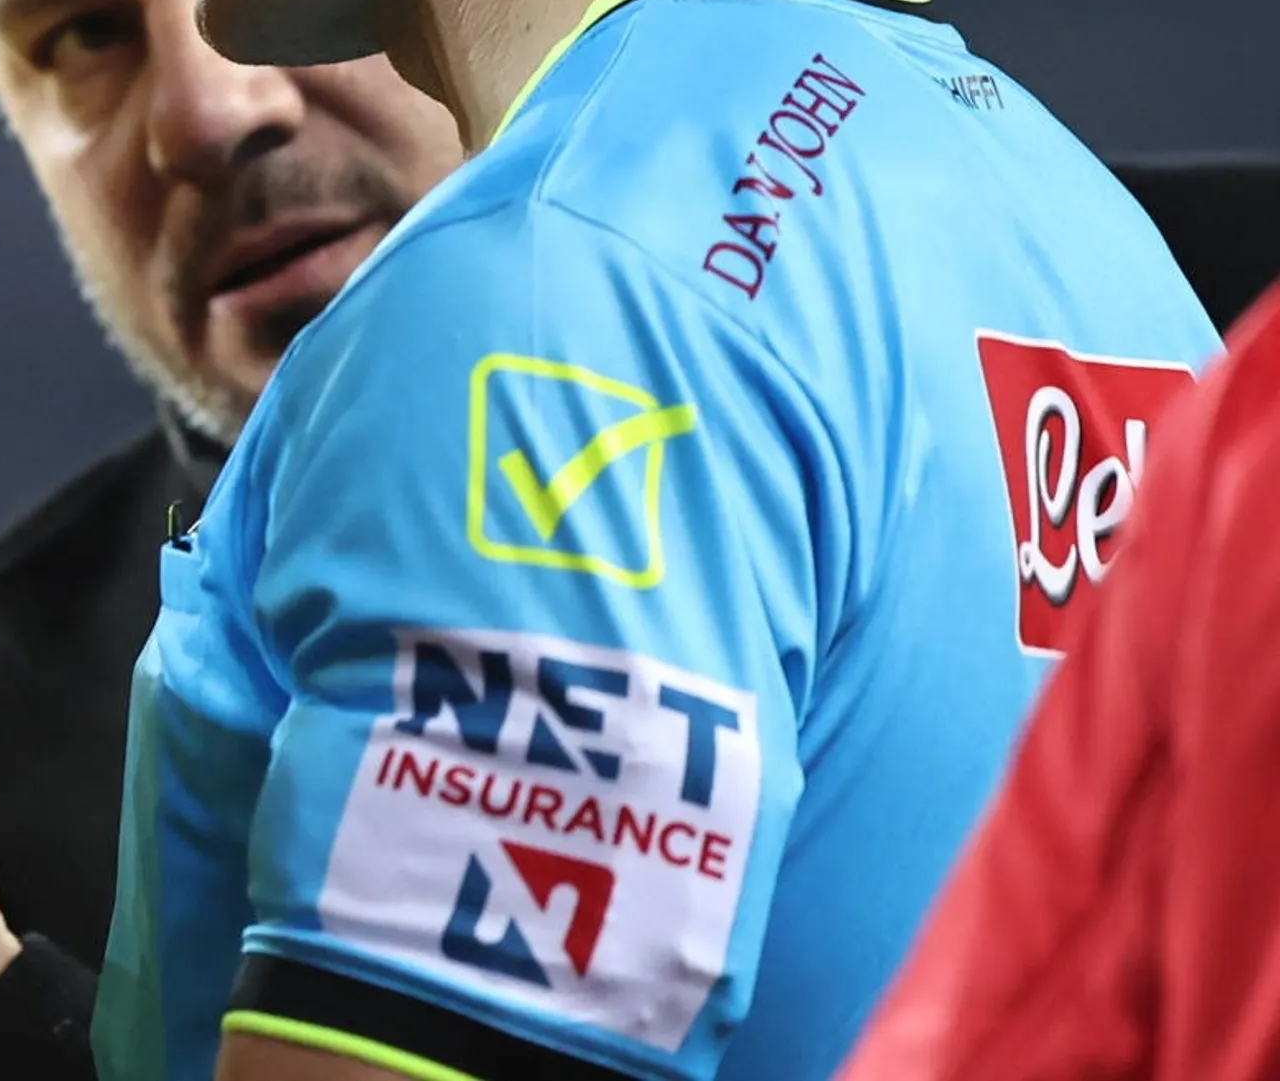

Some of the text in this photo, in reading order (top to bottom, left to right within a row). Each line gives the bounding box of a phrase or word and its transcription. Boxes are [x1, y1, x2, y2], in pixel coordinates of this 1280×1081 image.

[756, 52, 867, 198] JOHN
[393, 640, 740, 810] NET
[375, 746, 734, 882] INSURANCE
